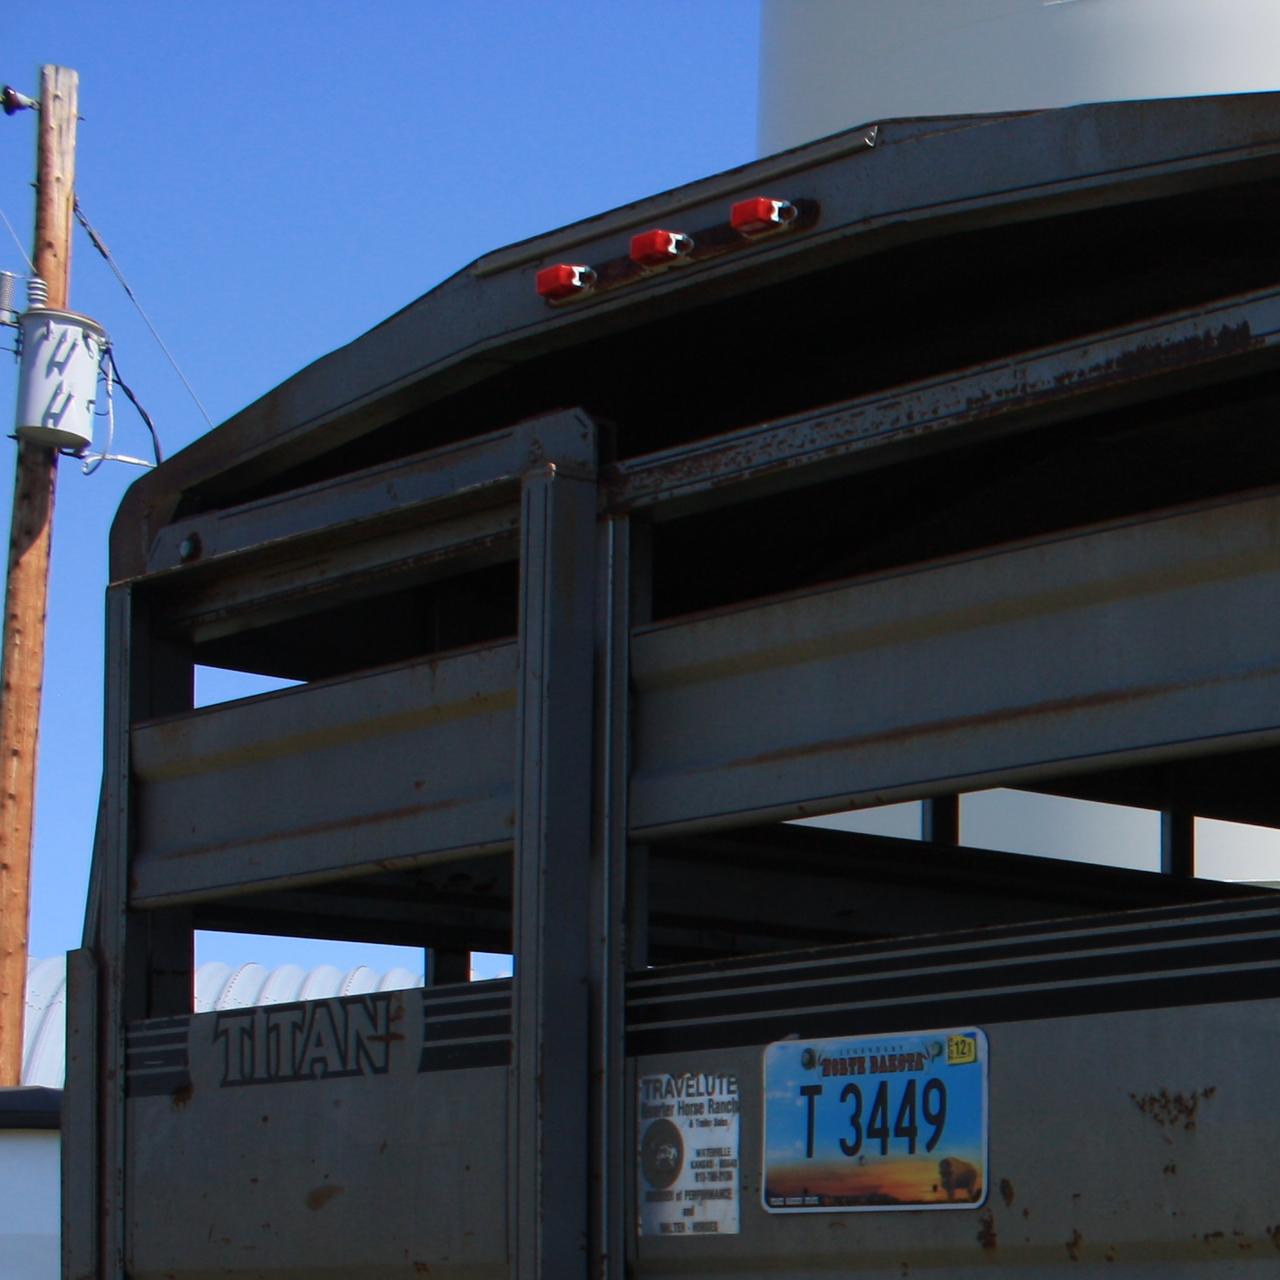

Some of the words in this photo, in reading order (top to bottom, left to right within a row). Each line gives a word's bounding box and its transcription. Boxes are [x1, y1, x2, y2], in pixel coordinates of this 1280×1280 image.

[213, 994, 393, 1087] TITAN
[821, 1057, 866, 1077] NORTH
[869, 1052, 925, 1075] DAKOTA
[642, 1075, 737, 1100] TRAVELUTE
[677, 1100, 704, 1116] Horse
[708, 1097, 741, 1114] Ranch
[800, 1085, 822, 1158] T
[839, 1077, 947, 1157] 3449
